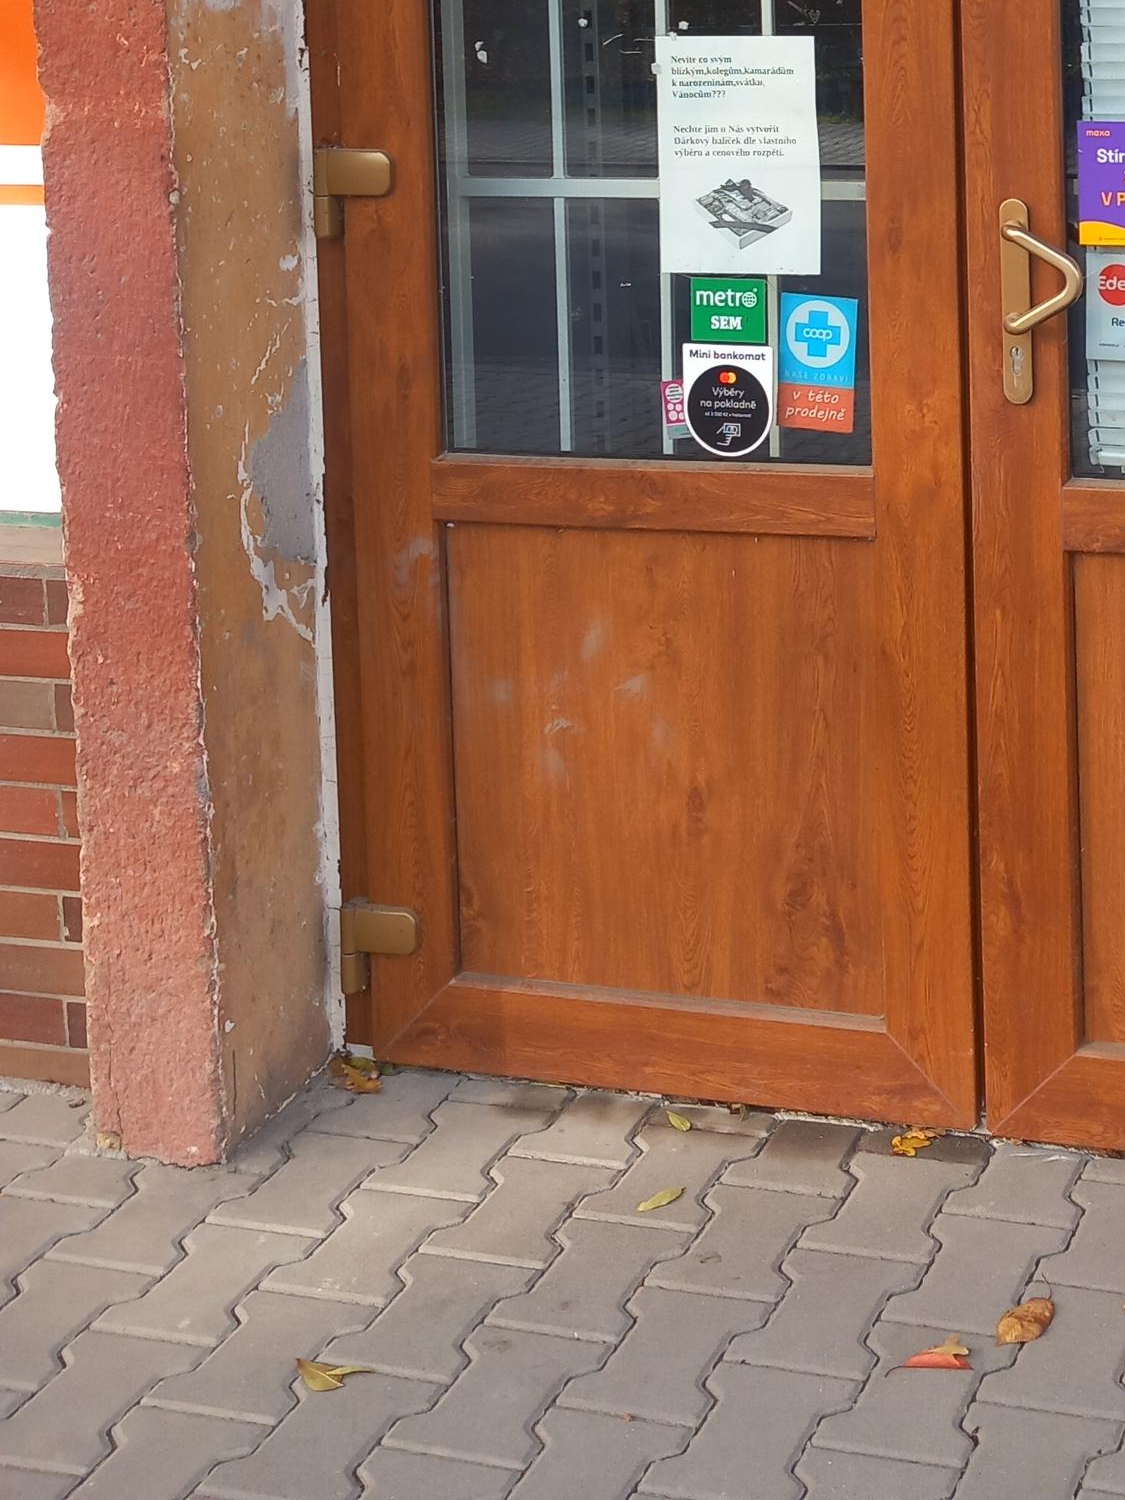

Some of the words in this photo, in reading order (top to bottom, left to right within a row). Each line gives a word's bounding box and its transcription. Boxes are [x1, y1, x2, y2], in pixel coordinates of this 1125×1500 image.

[671, 79, 677, 87] k
[673, 125, 702, 133] Nechte
[743, 137, 756, 145] dle
[1101, 192, 1112, 206] V
[695, 288, 757, 308] metro
[710, 315, 743, 331] SEM
[802, 327, 833, 341] coop
[689, 349, 711, 360] Mini
[713, 350, 766, 362] bankomat
[711, 386, 745, 398] Výběry
[793, 391, 801, 400] v
[808, 389, 839, 404] této
[700, 399, 713, 408] na
[714, 399, 757, 410] pokladně
[785, 405, 846, 421] prodejně
